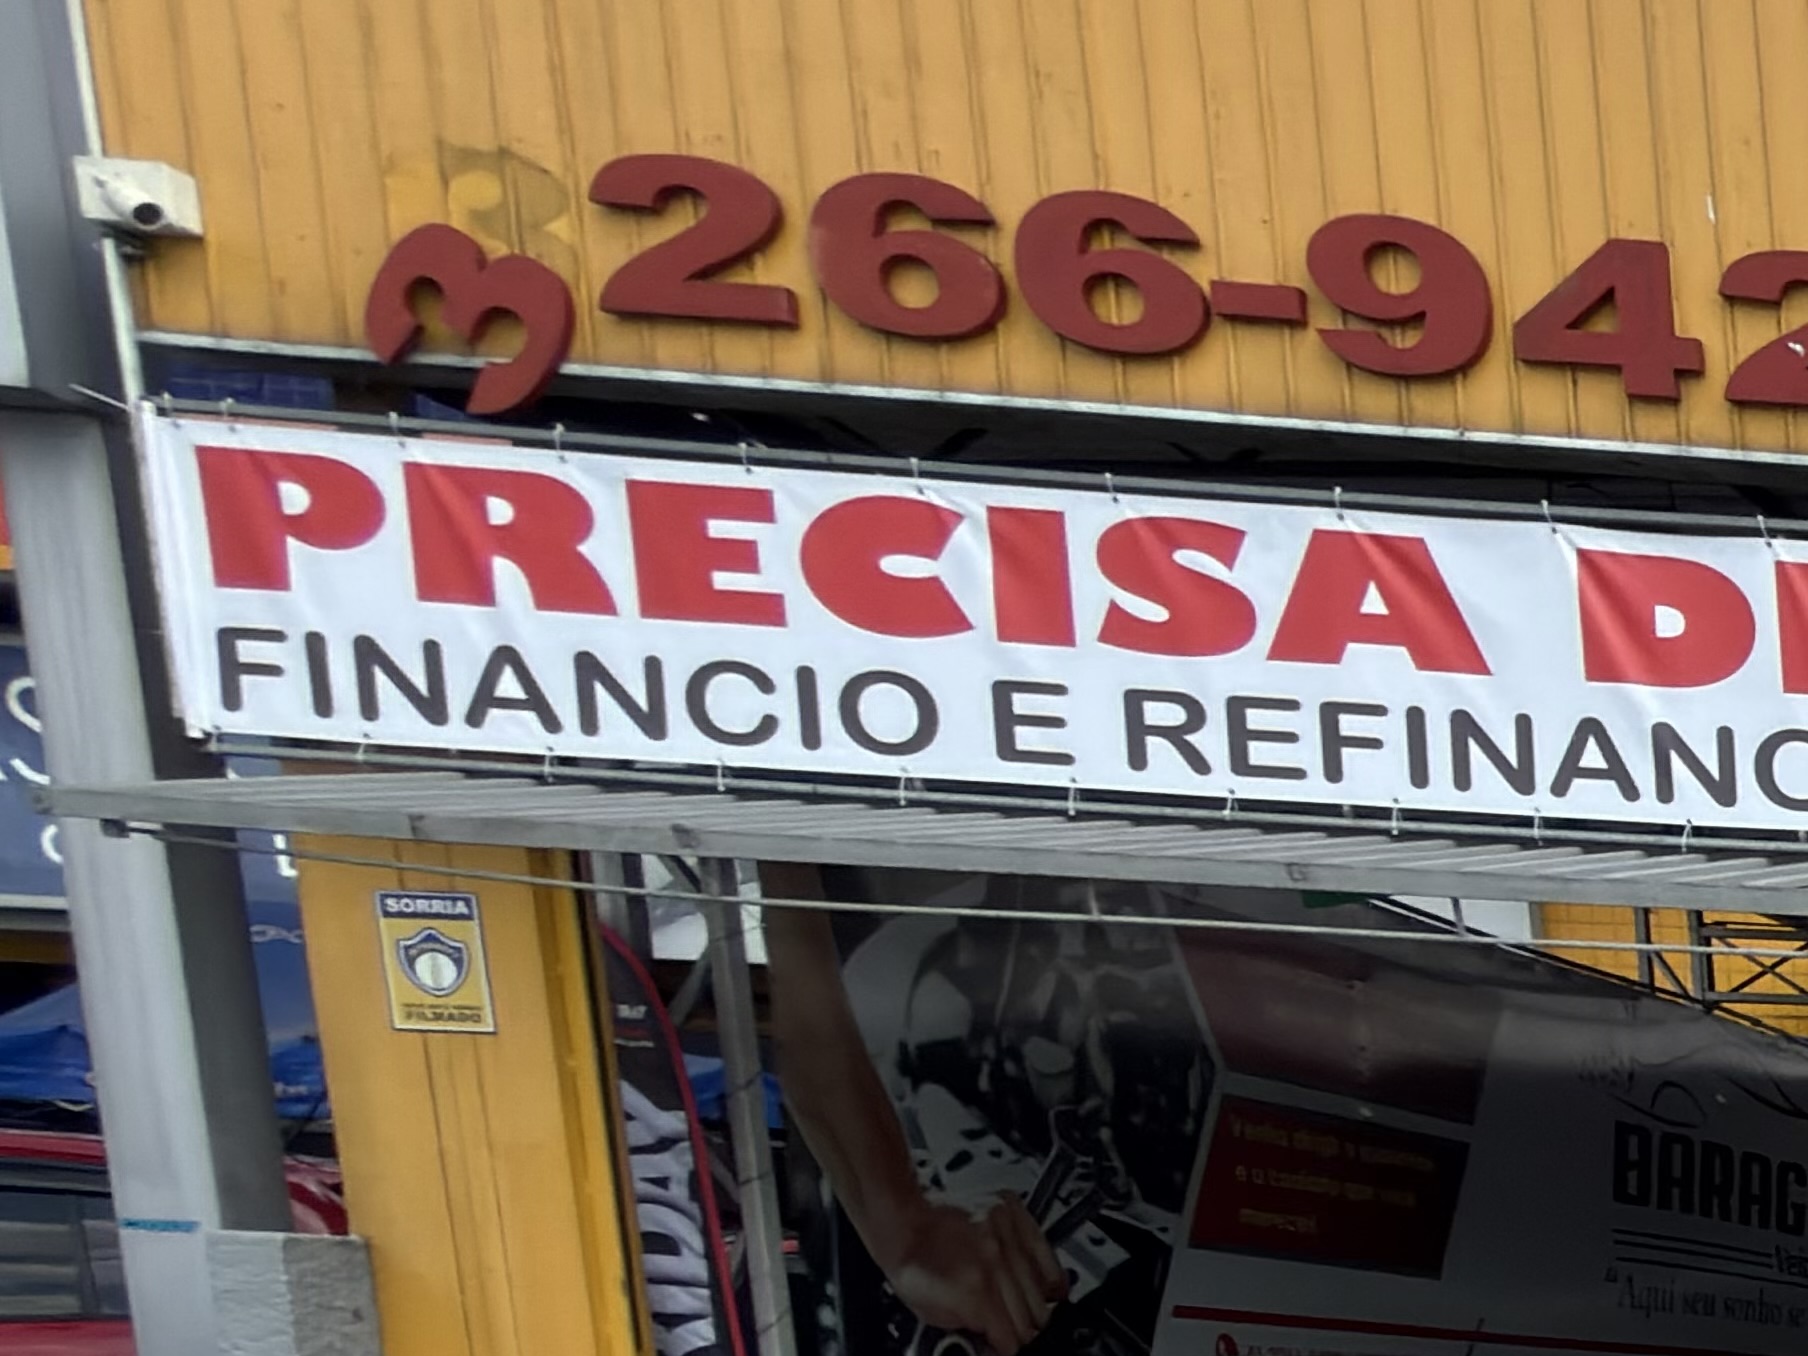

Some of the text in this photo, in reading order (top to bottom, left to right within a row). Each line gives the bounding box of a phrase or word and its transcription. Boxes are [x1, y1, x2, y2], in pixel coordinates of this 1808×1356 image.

[195, 444, 1491, 676] PRECISA
[215, 627, 938, 759] FINANCIO
[991, 678, 1073, 766] E
[385, 897, 470, 915] SORRIA
